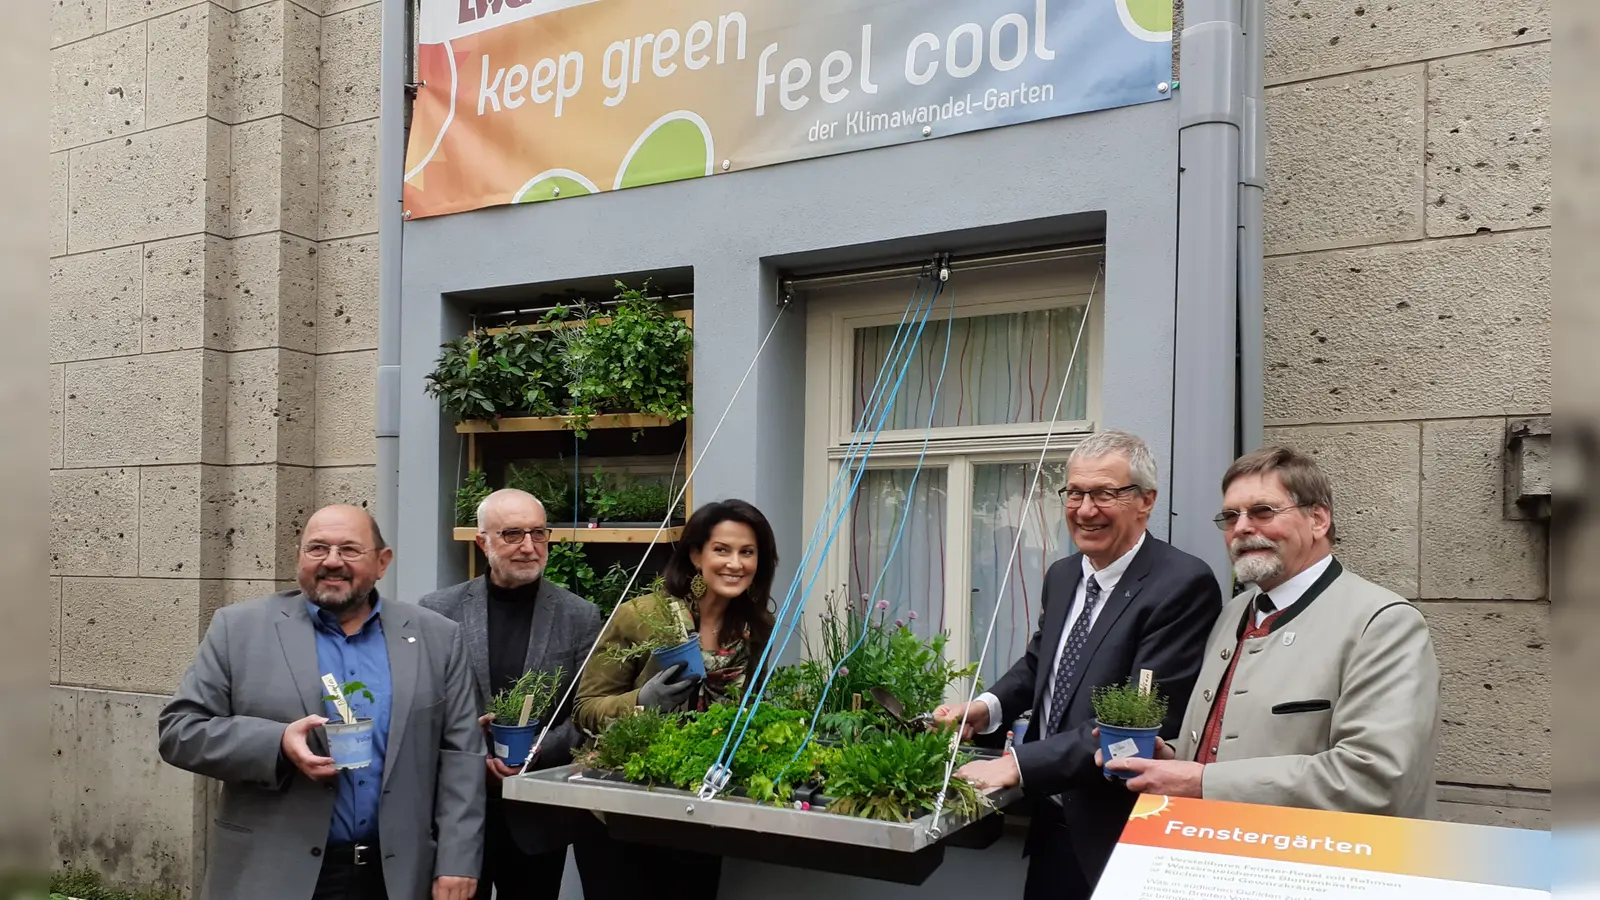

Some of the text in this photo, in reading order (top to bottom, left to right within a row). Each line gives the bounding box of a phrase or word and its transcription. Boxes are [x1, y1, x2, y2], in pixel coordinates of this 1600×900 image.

[477, 11, 747, 118] keep green
[755, 0, 1055, 116] feel cool
[808, 83, 1054, 141] der Klimawandel-Garten
[1164, 820, 1372, 856] Fenstergärten
